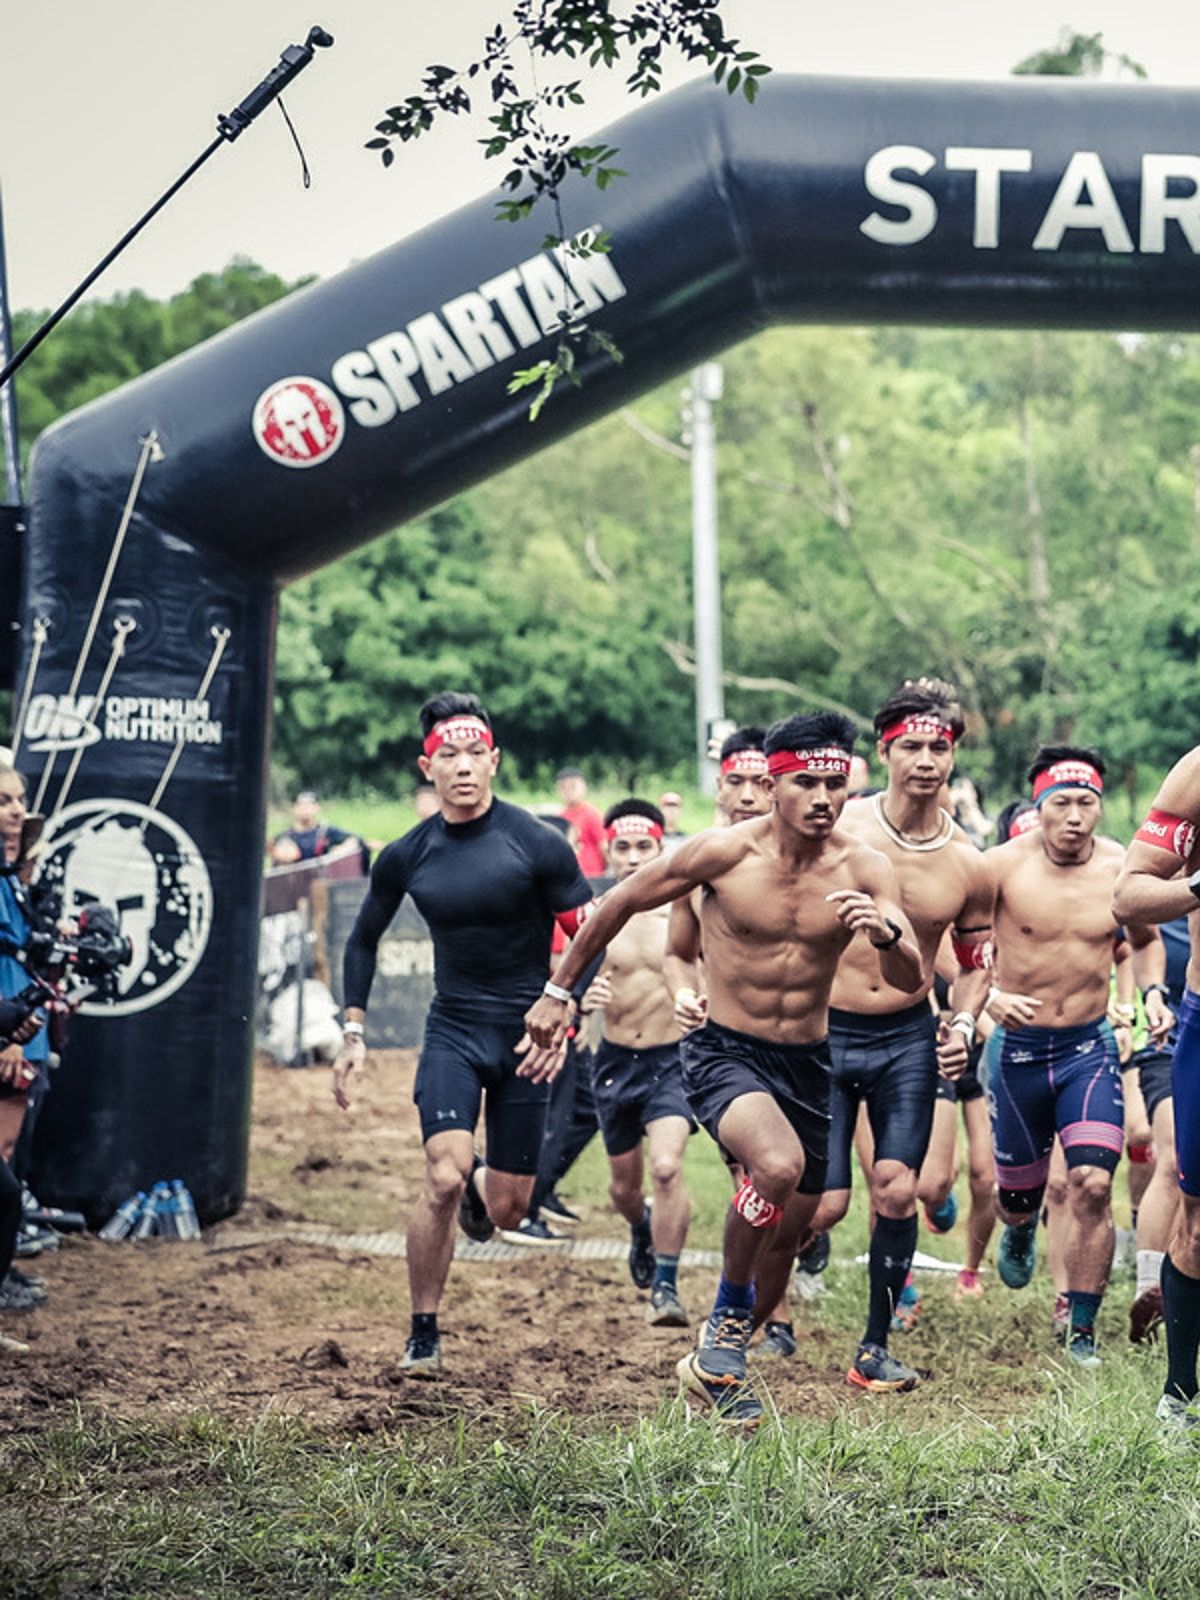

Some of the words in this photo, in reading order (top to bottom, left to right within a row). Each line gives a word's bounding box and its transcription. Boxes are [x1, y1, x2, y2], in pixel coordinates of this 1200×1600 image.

[331, 225, 627, 428] SPARTAN
[105, 695, 211, 721] OPTIMUM
[104, 718, 223, 744] NUTRITION
